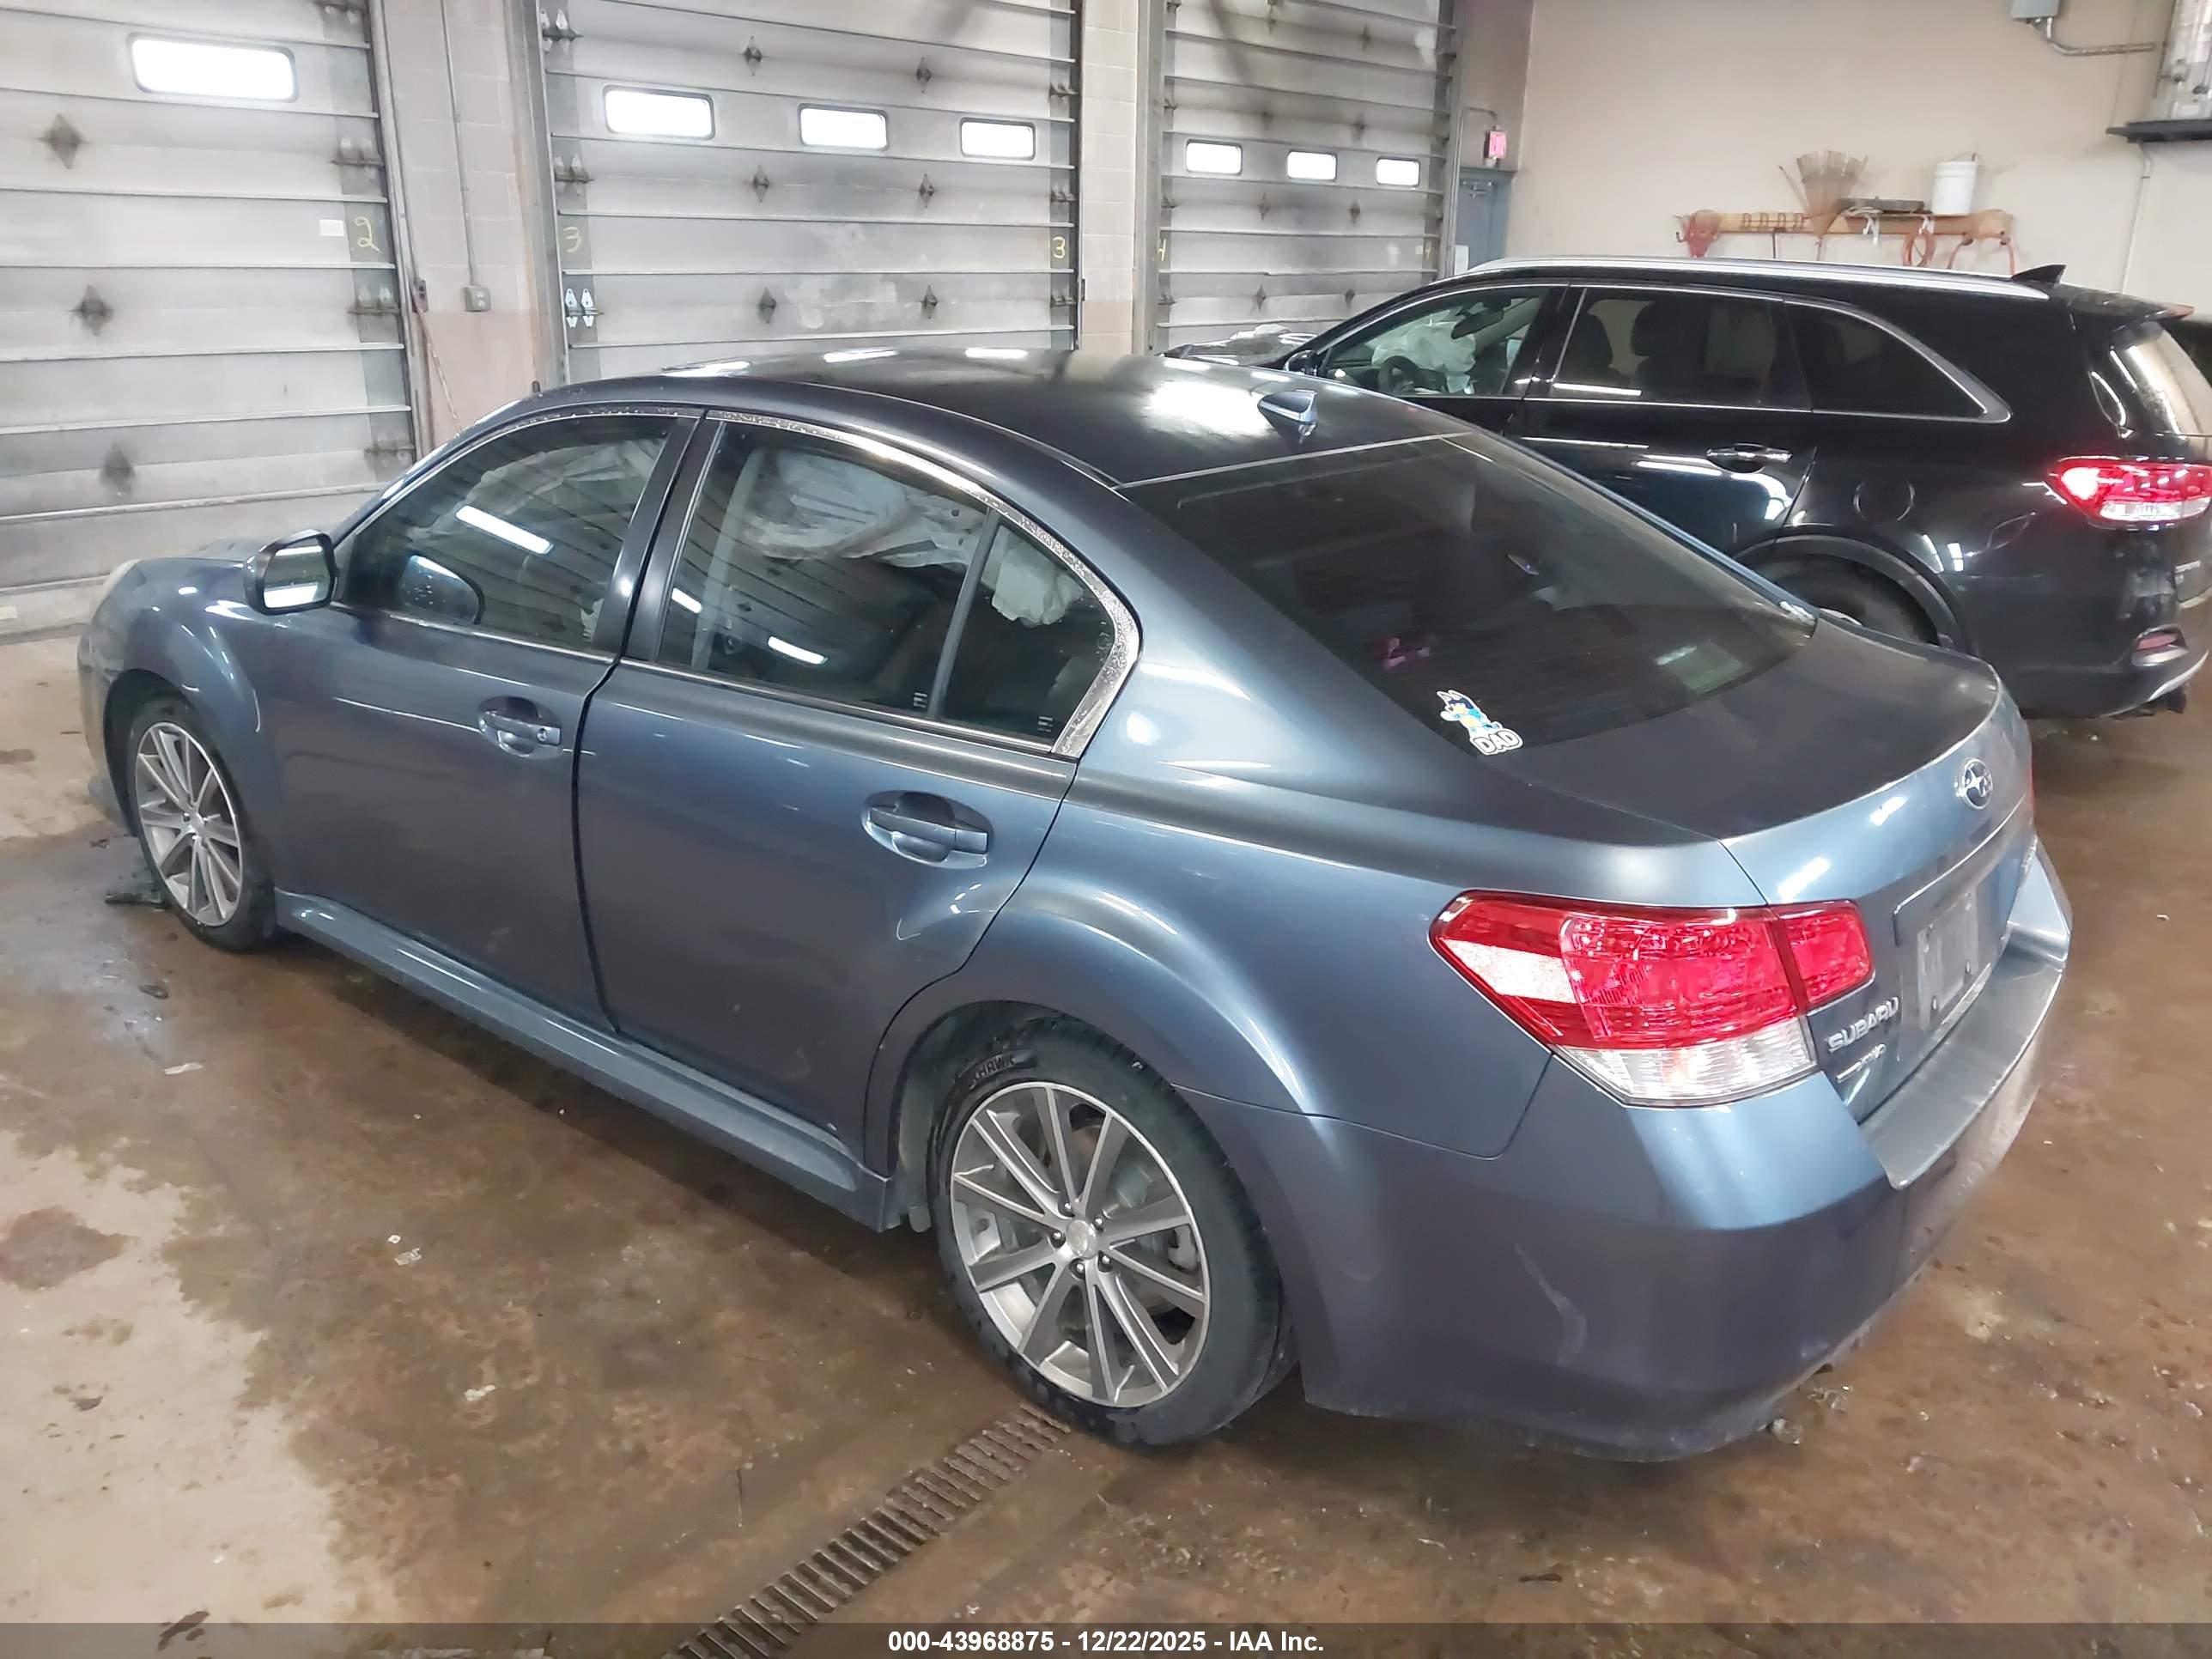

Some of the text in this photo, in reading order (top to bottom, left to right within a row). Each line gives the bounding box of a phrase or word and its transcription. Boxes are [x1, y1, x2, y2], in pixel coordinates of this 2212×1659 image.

[354, 216, 380, 252] 2
[562, 226, 582, 254] 3
[1052, 235, 1066, 259] 3
[1473, 730, 1521, 755] DAD
[1826, 996, 1899, 1053] SUBARU
